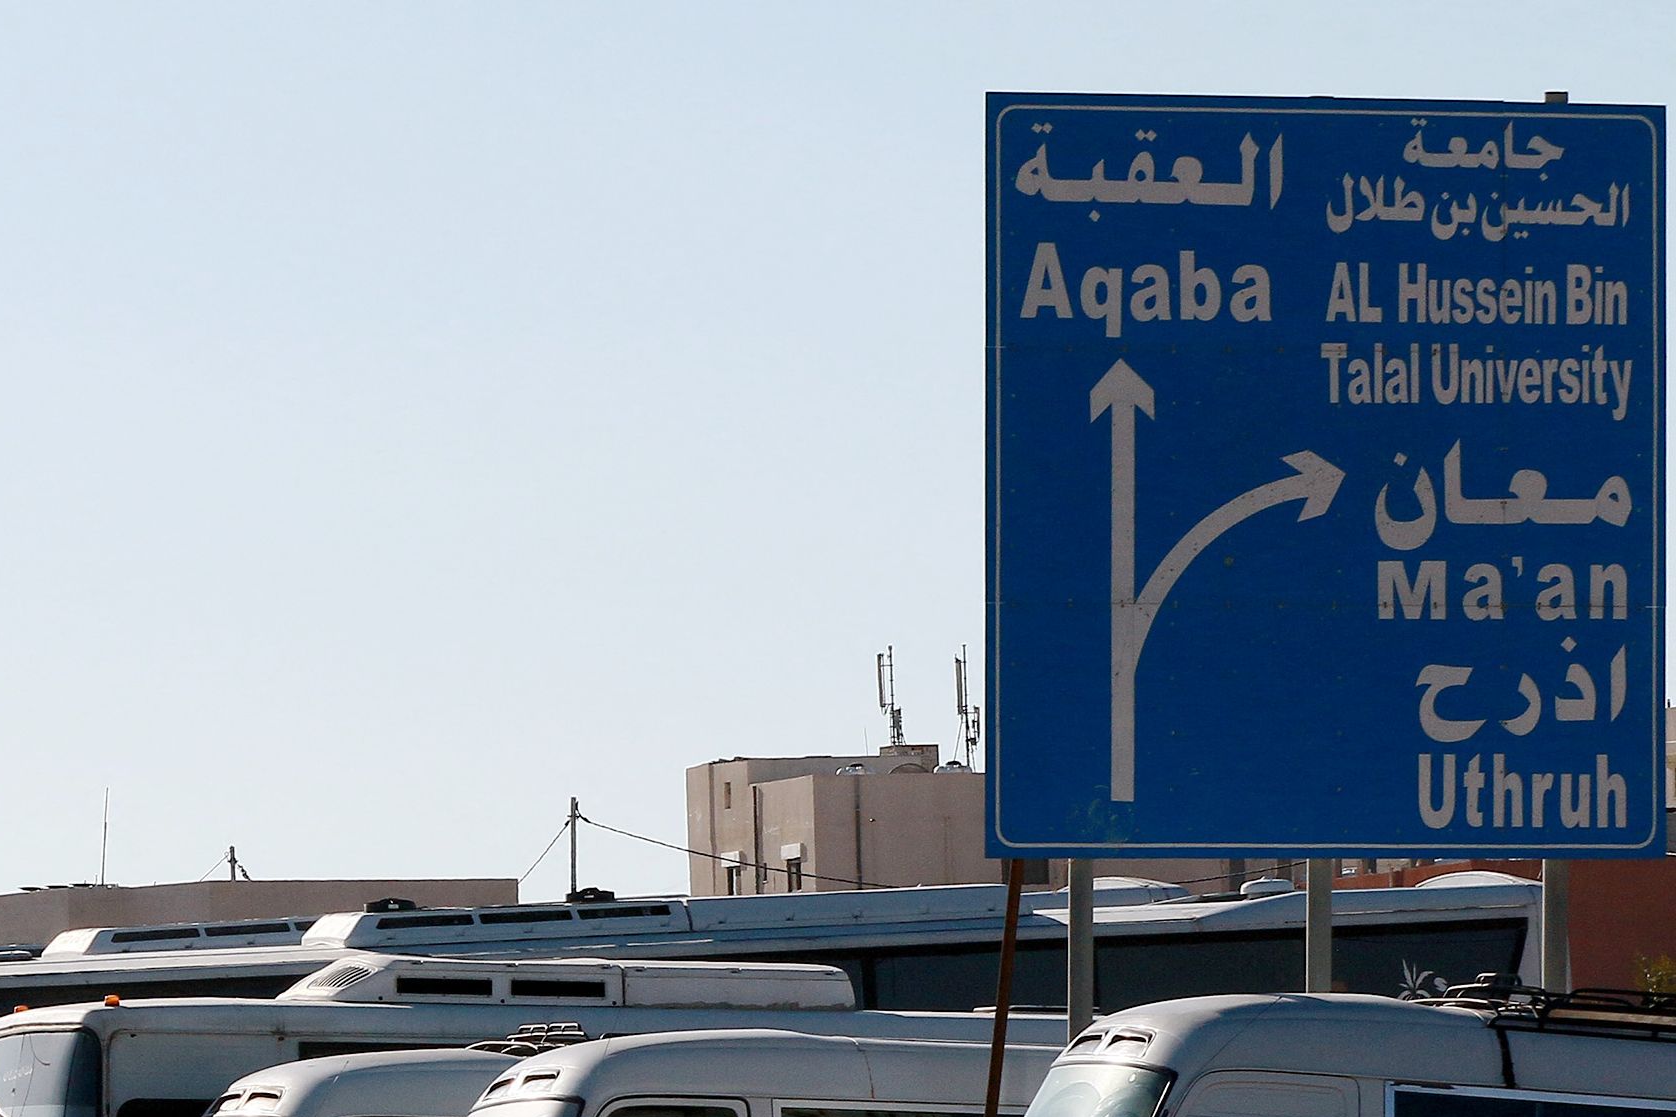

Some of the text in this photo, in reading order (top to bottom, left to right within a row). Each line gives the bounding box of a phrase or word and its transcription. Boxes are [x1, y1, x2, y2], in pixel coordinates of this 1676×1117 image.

[1016, 122, 1284, 221] العقبة
[1402, 117, 1565, 181] جامعة
[1326, 172, 1630, 242] الحسين بن طلال
[1020, 242, 1272, 338] Aqaba
[1326, 262, 1628, 326] AL Hussein Bin
[1321, 343, 1632, 421] Talal University
[1374, 438, 1633, 550] معان
[1377, 556, 1628, 622] Ma'an
[1416, 637, 1627, 743] اذرح
[1418, 753, 1628, 829] Uthruh
